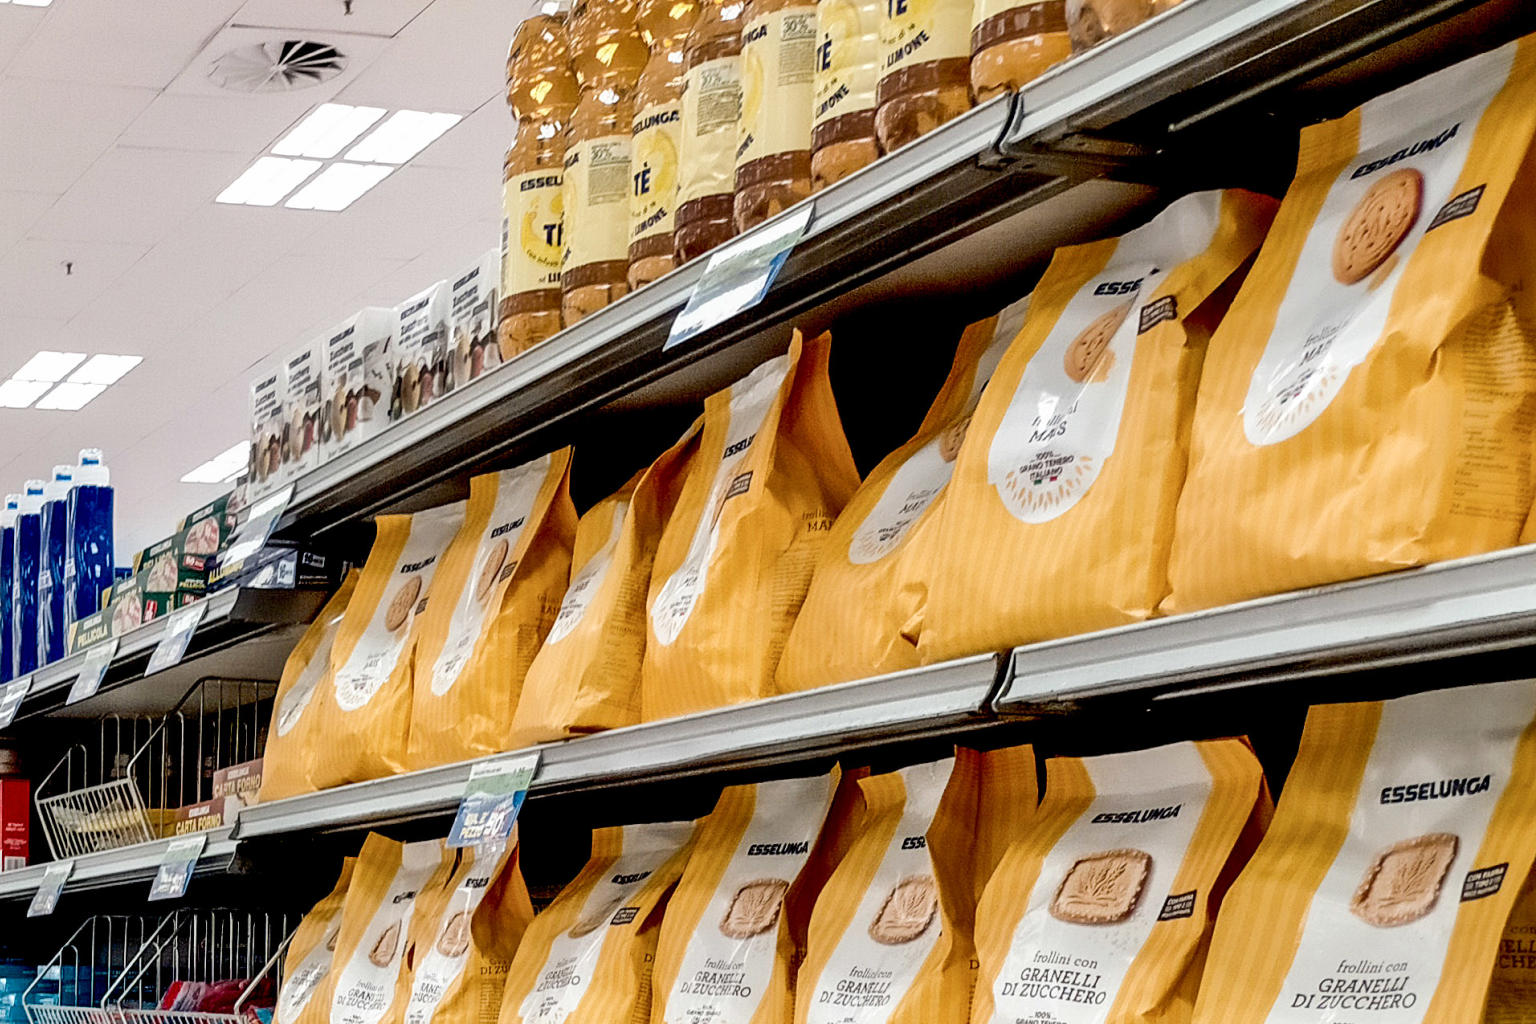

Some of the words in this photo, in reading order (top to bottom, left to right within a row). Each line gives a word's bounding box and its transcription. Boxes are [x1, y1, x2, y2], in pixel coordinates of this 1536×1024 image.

[1350, 121, 1461, 180] ESSELUNGA
[1380, 774, 1491, 804] ESSELUNGA
[197, 812, 221, 832] FORNO
[1091, 803, 1182, 824] ESSELUNGA
[747, 840, 809, 857] ESSELUNGA
[1033, 950, 1072, 966] frollini
[1073, 958, 1098, 969] con
[1336, 959, 1383, 974] frollini
[1384, 961, 1408, 973] con
[694, 970, 746, 985] GRANELLI
[1020, 967, 1101, 989] GRANELLI
[1318, 976, 1410, 994] GRANELLI
[680, 983, 693, 994] DI
[692, 984, 752, 998] ZUCCHERO
[819, 991, 834, 1003] DI
[1002, 982, 1019, 996] DI
[1019, 983, 1107, 1005] ZUCCHERO
[1291, 993, 1316, 1008] DI
[1316, 992, 1417, 1010] ZUCCHERO
[1034, 1011, 1052, 1019] 100%
